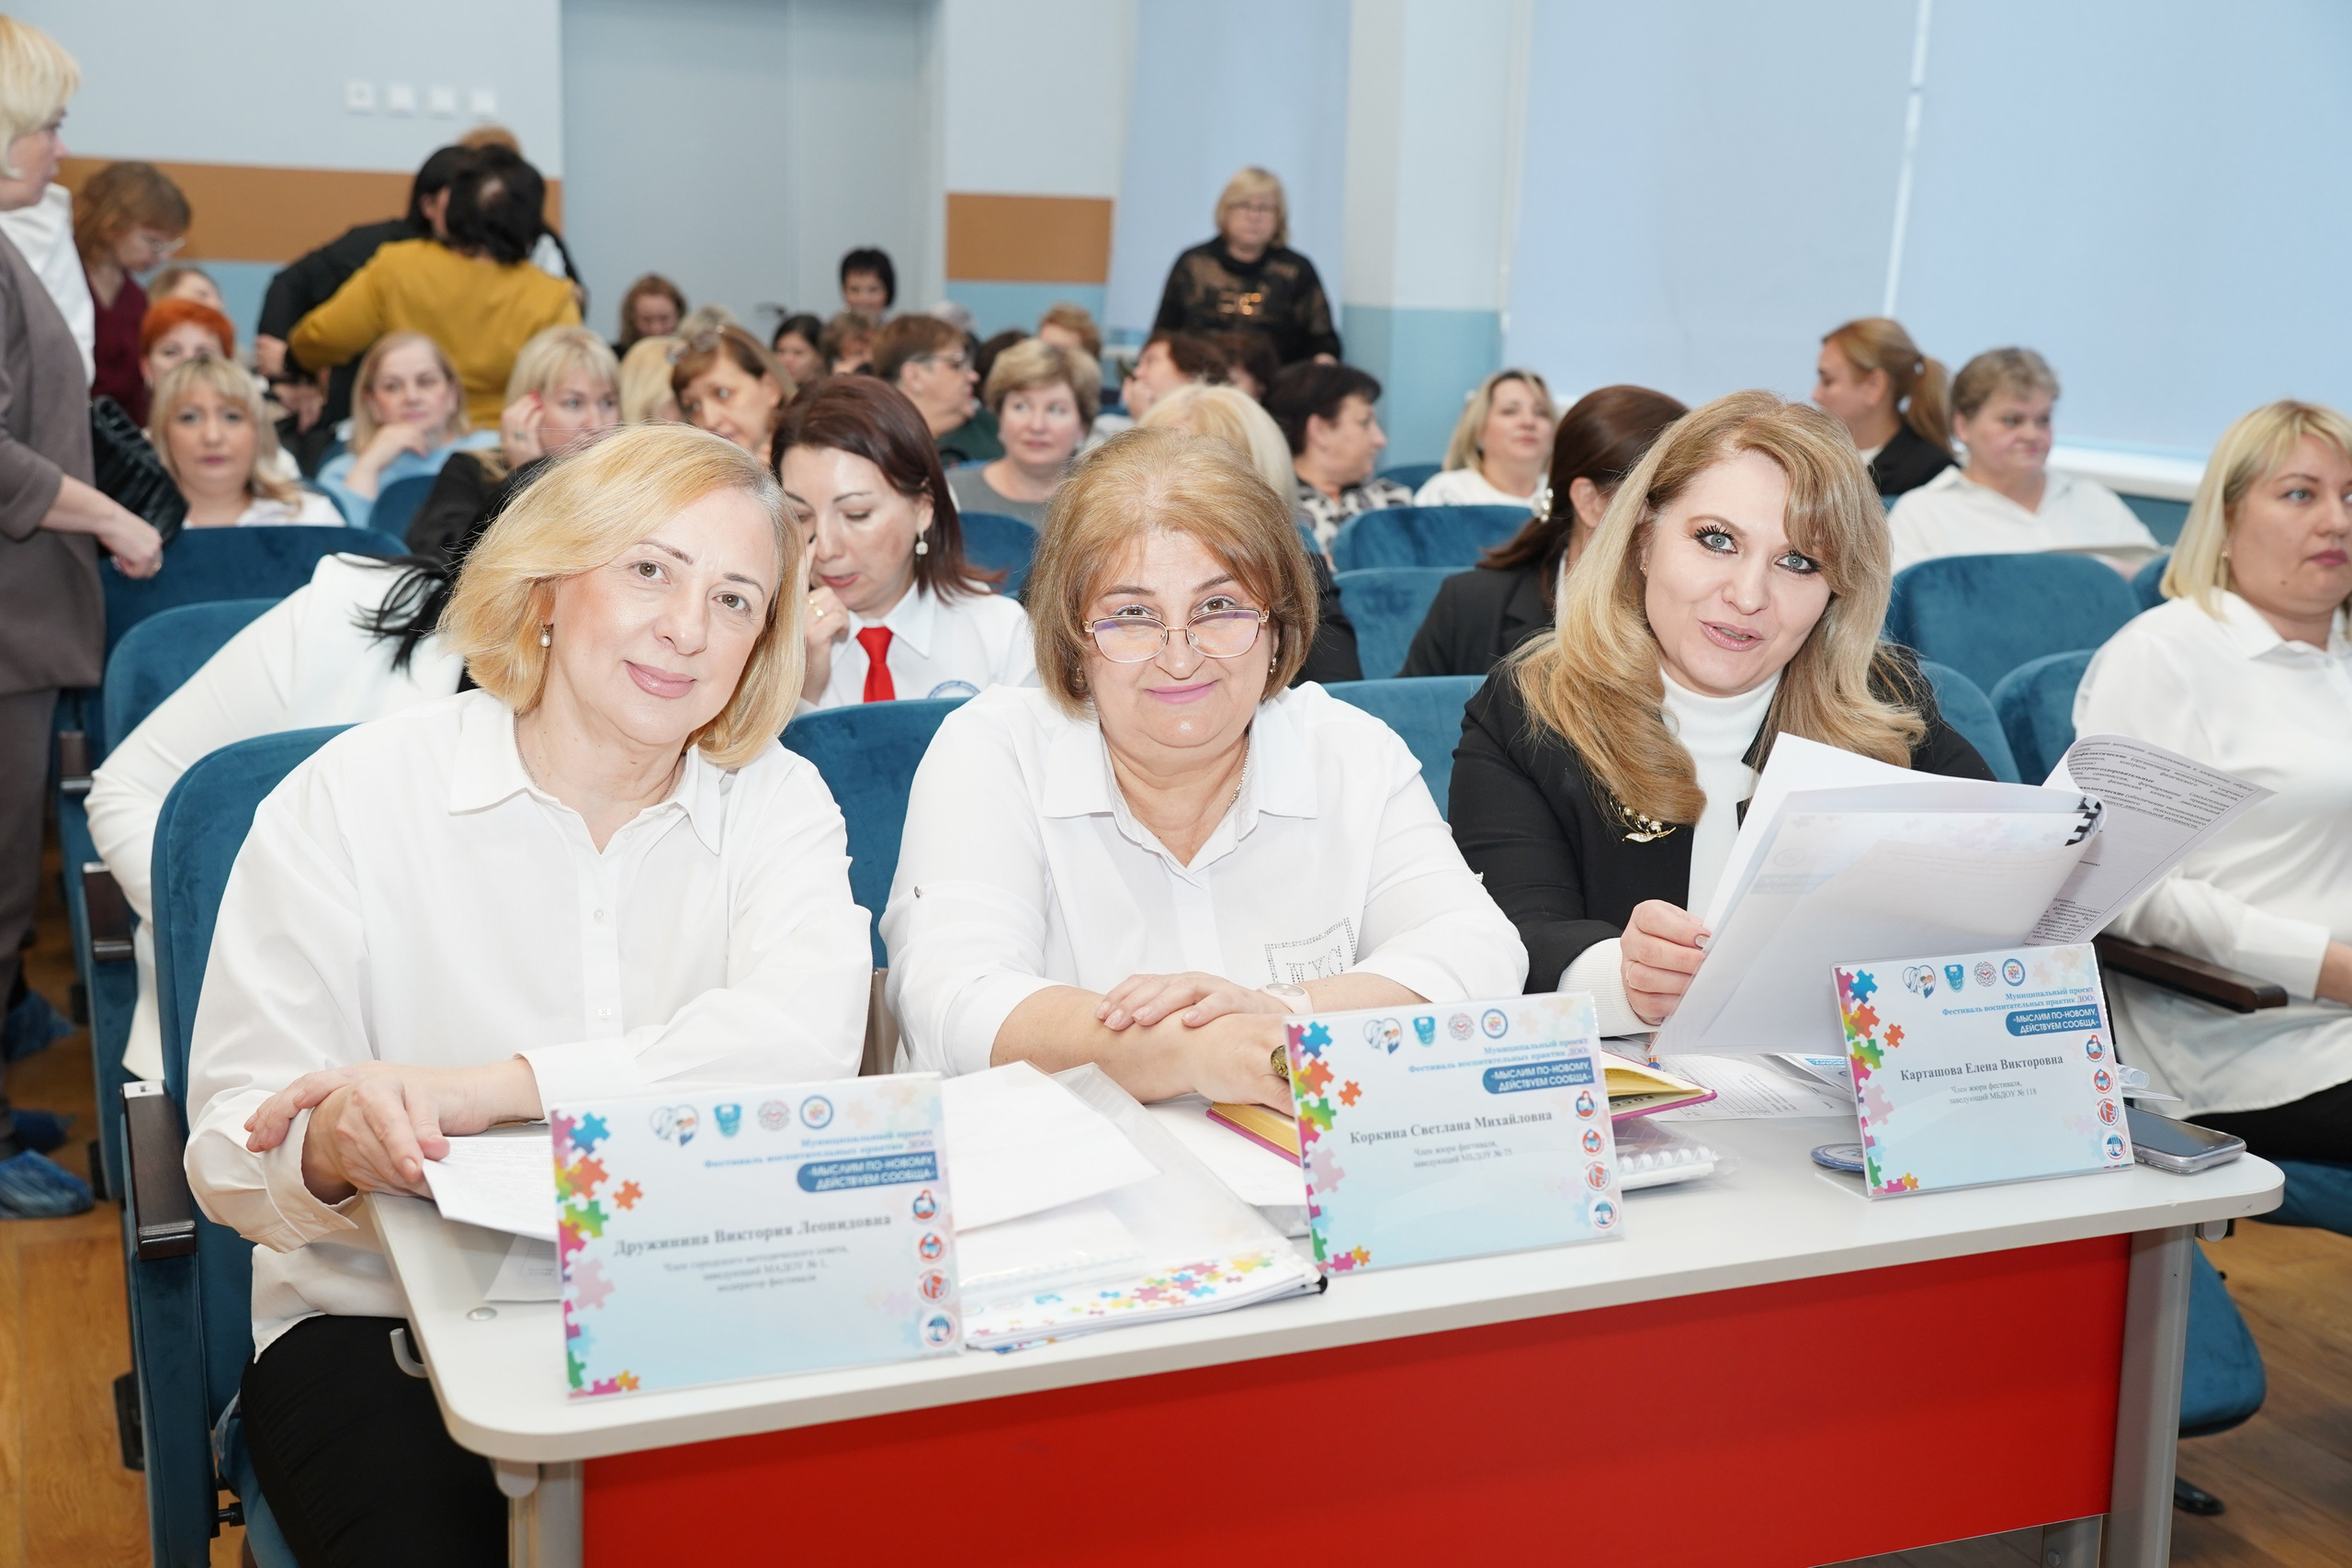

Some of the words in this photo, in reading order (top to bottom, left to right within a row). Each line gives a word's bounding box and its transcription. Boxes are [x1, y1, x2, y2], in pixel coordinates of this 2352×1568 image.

[2006, 989, 2068, 1000] Муниципальный
[1942, 1006, 1984, 1016] Фестиваль
[1984, 1000, 2045, 1011] воспитательных
[2046, 998, 2075, 1007] практик
[2019, 1021, 2062, 1034] ДЕЙСТВУЕМ
[1484, 1041, 1557, 1055] Муниципальный
[1559, 1038, 1588, 1048] проект
[1408, 1062, 1456, 1073] Фестиваль
[1457, 1055, 1529, 1068] воспитательных
[1531, 1050, 1566, 1061] практик
[1900, 1066, 1962, 1082] Карташова
[1965, 1061, 1998, 1074] Елена
[2000, 1056, 2064, 1070] Викторовна
[1498, 1077, 1548, 1092] ДЕЙСТВУЕМ
[1951, 1086, 1967, 1094] Член
[1968, 1084, 1988, 1094] жюри
[1988, 1080, 2022, 1090] фестиваля,
[1949, 1093, 1989, 1105] заведующий
[1989, 1089, 2016, 1100] МБДОУ
[2017, 1089, 2025, 1097] №
[2026, 1088, 2037, 1096] 118
[1350, 1130, 1408, 1145] Коркина
[1410, 1122, 1471, 1137] Светлана
[1474, 1111, 1553, 1129] Михайловна
[613, 1237, 709, 1258] Дружинина
[714, 1224, 793, 1244] Виктория
[797, 1215, 892, 1235] Леонидовна
